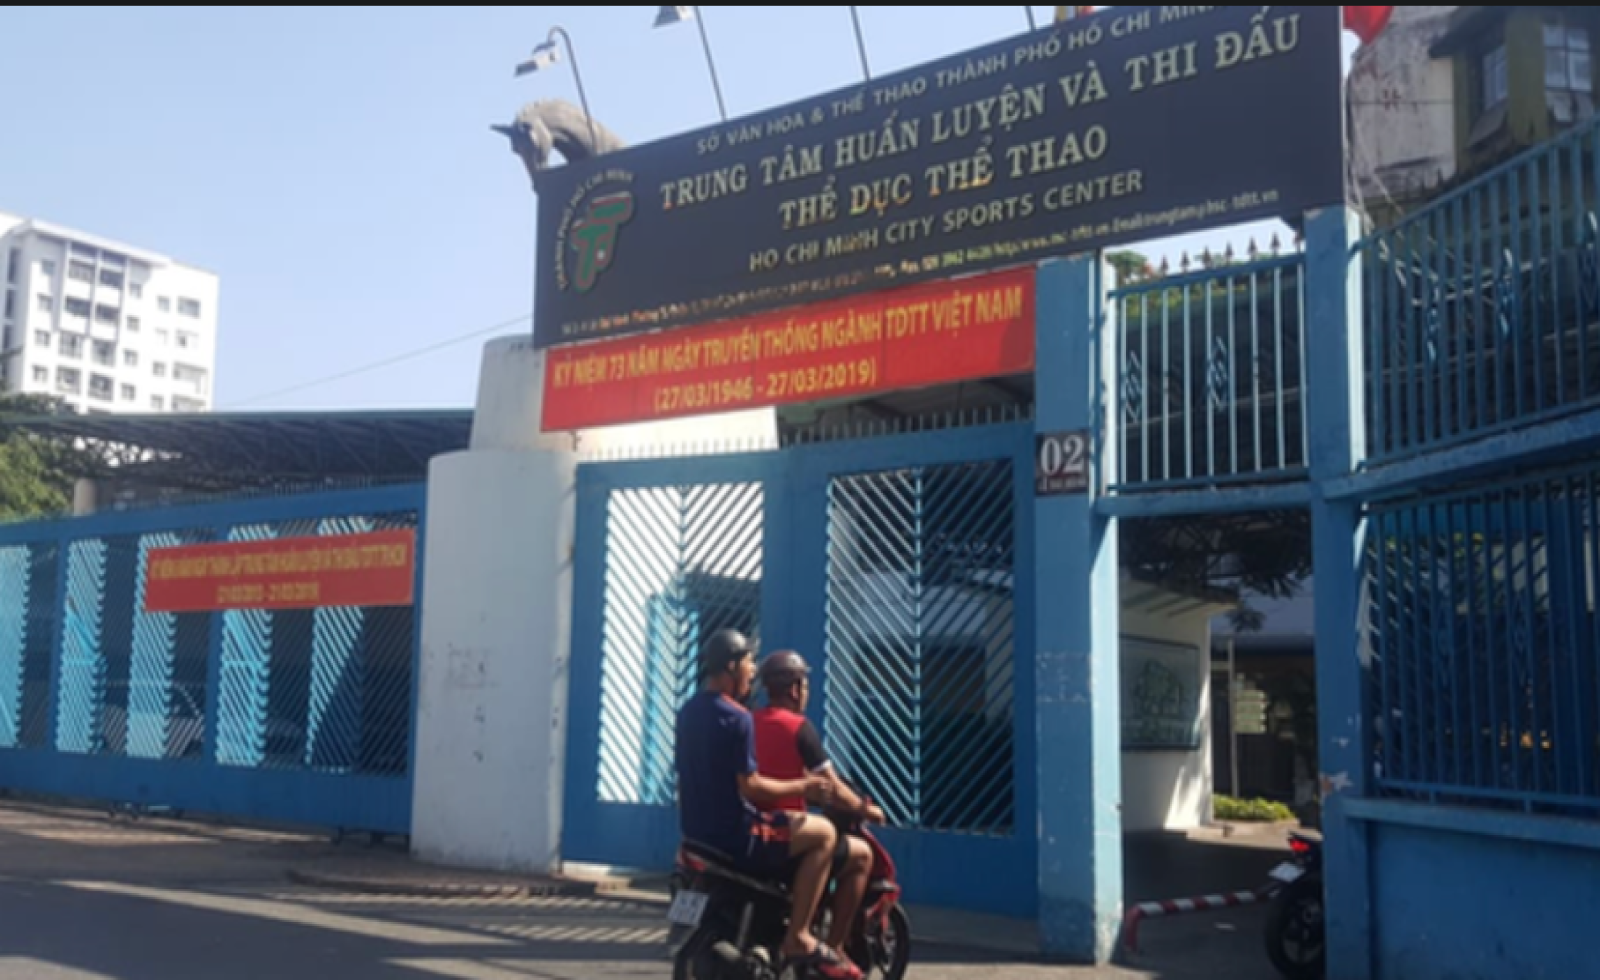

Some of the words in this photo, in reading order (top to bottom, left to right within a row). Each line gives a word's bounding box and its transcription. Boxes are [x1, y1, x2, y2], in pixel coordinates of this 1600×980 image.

[874, 76, 927, 106] THAO
[1110, 10, 1150, 37] CHI
[660, 162, 747, 210] TRUNG
[760, 144, 823, 186] TÂM
[835, 104, 920, 168] HUẤN
[931, 82, 1045, 143] LUYỆN
[1058, 59, 1109, 107] VÀ
[1124, 41, 1198, 92] THI
[1215, 6, 1301, 69] ĐẤU
[779, 174, 838, 230] THỂ
[849, 172, 913, 217] DỤC
[925, 134, 995, 197] THỂ
[1006, 125, 1108, 178] THAO
[785, 240, 820, 263] CHI
[885, 214, 935, 244] CITY
[942, 193, 1034, 233] SPORTS
[1043, 170, 1143, 211] CENTER
[608, 353, 625, 382] 73
[885, 301, 928, 341] TDTT
[932, 289, 972, 338] VIỆT
[975, 285, 1023, 325] NAM
[655, 375, 753, 413] (27/03/1946
[767, 355, 877, 397] 27/03/2019)
[1040, 434, 1084, 476] 02
